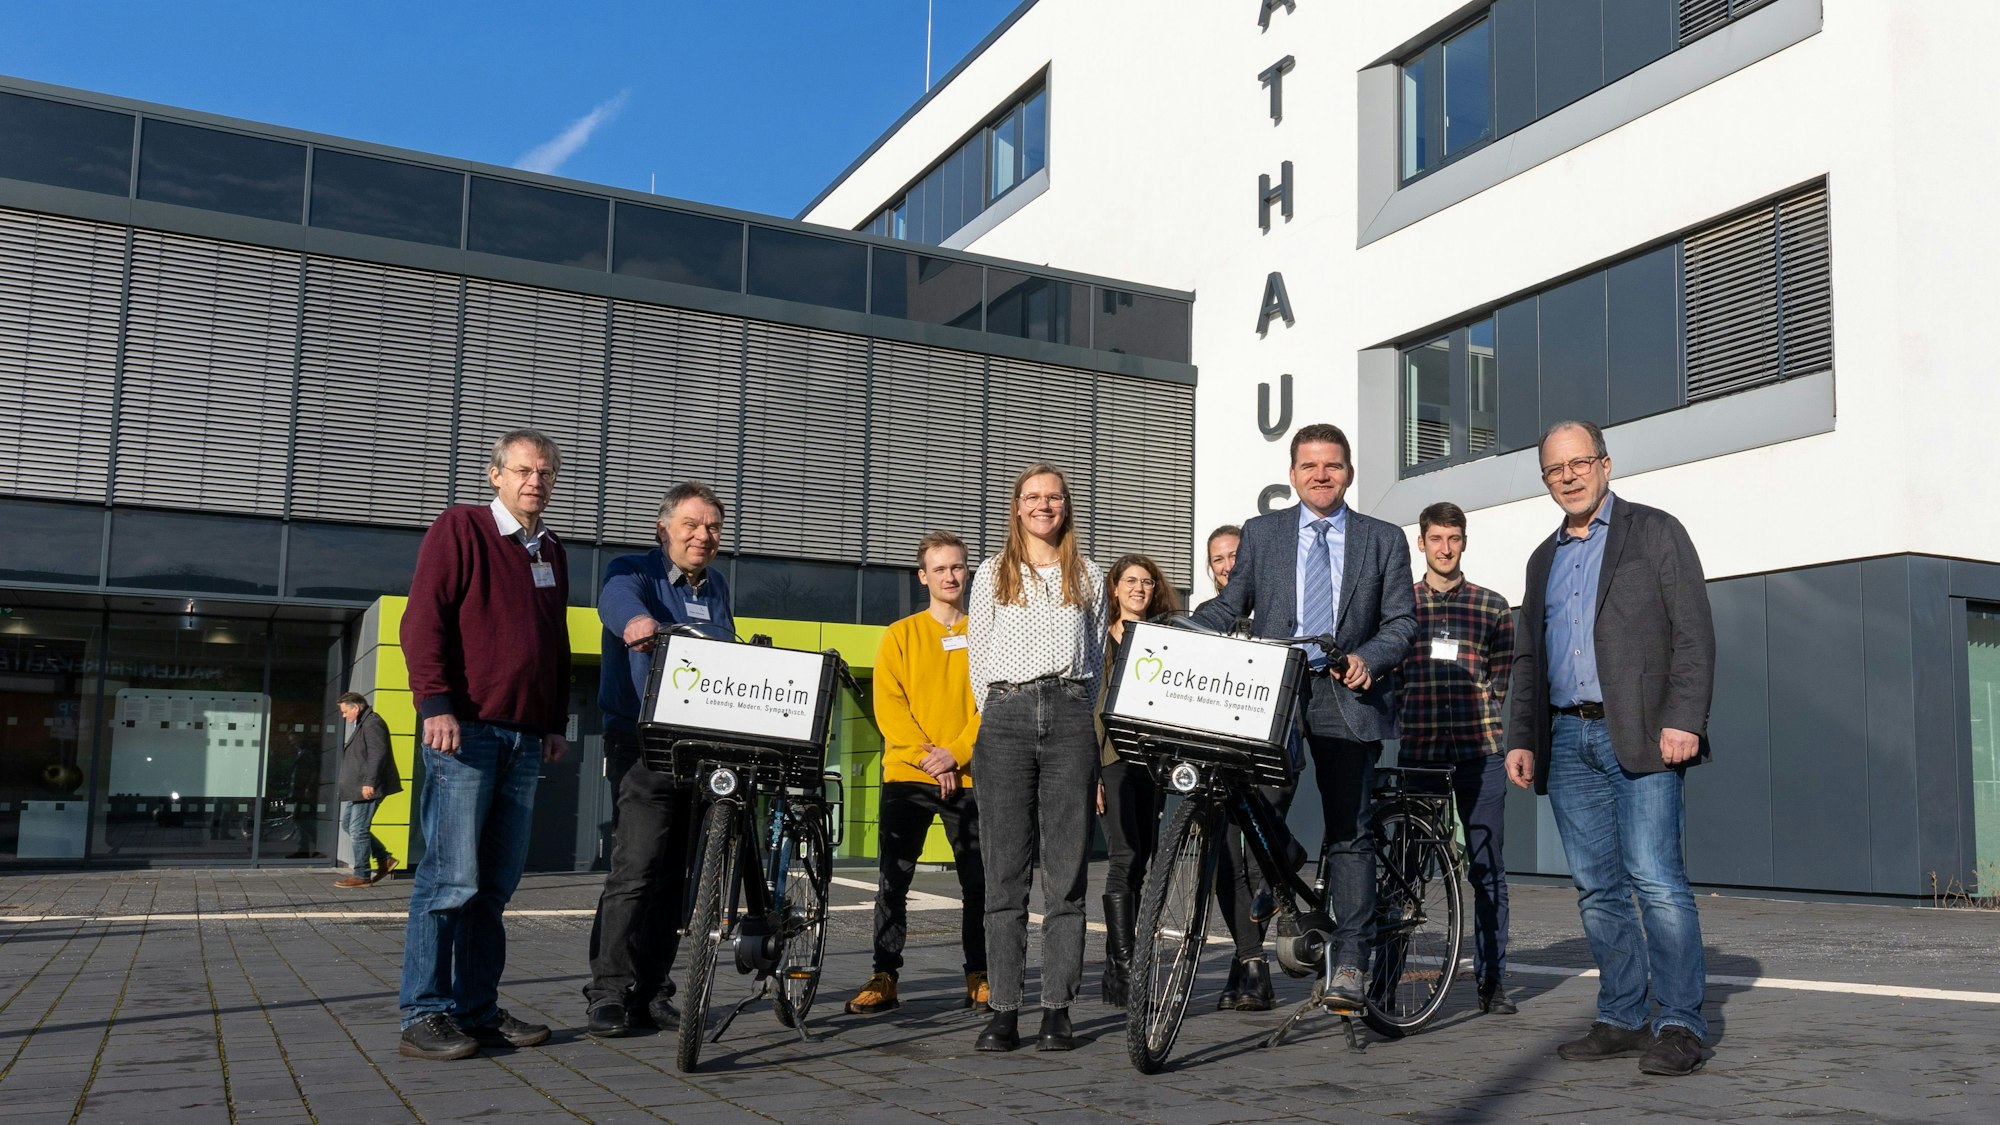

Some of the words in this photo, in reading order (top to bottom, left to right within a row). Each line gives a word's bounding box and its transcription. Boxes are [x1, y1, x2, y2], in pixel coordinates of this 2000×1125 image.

[672, 667, 809, 705] Meckenheim
[1135, 656, 1270, 702] Meckenheim
[705, 697, 735, 709] Lebendig.
[737, 701, 762, 712] Modern.
[764, 704, 806, 717] Sympathisch.
[1165, 690, 1194, 703] Lebendig.
[1197, 695, 1222, 707] Modern.
[1224, 699, 1266, 714] Sympathisch.
